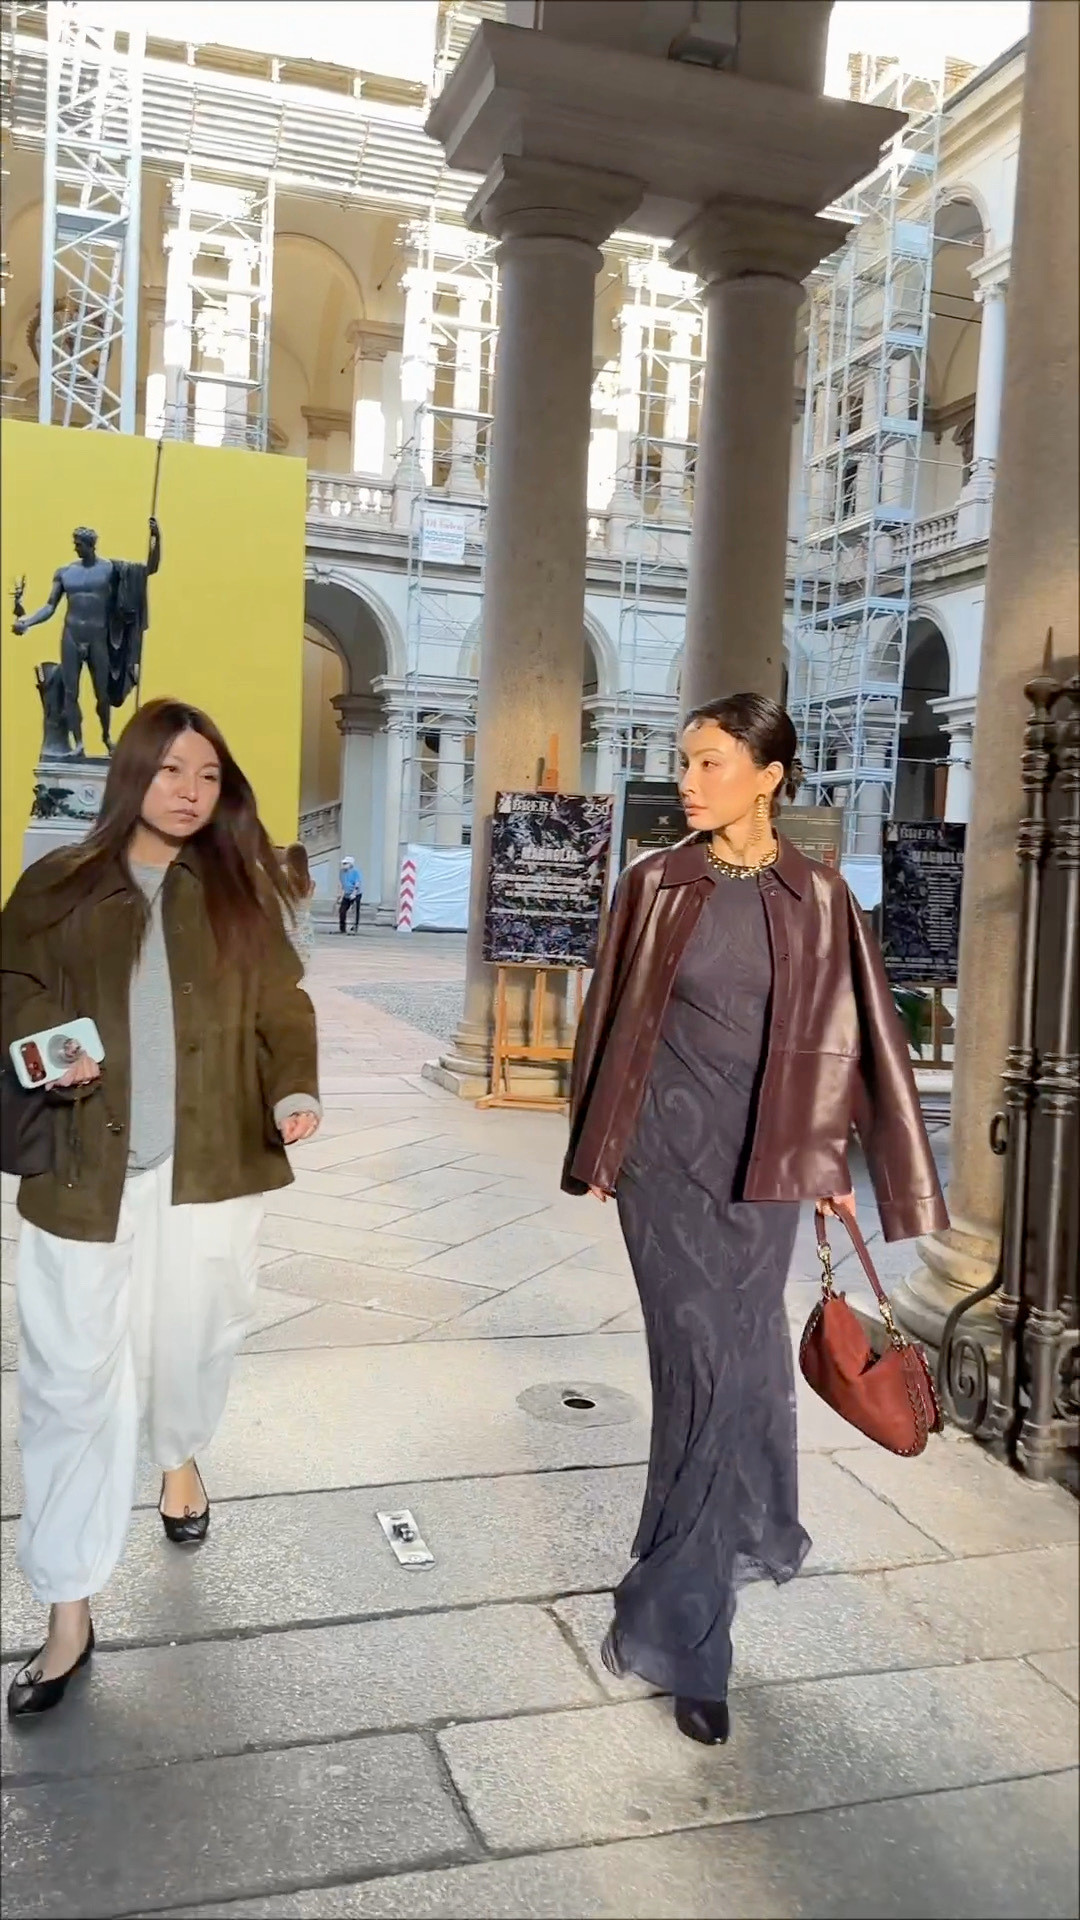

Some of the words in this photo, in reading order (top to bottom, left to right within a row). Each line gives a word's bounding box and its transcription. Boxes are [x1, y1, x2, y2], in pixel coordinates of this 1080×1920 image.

[84, 789, 95, 799] N
[512, 800, 559, 814] BRERA
[588, 804, 609, 816] 250
[900, 828, 944, 840] BRERA
